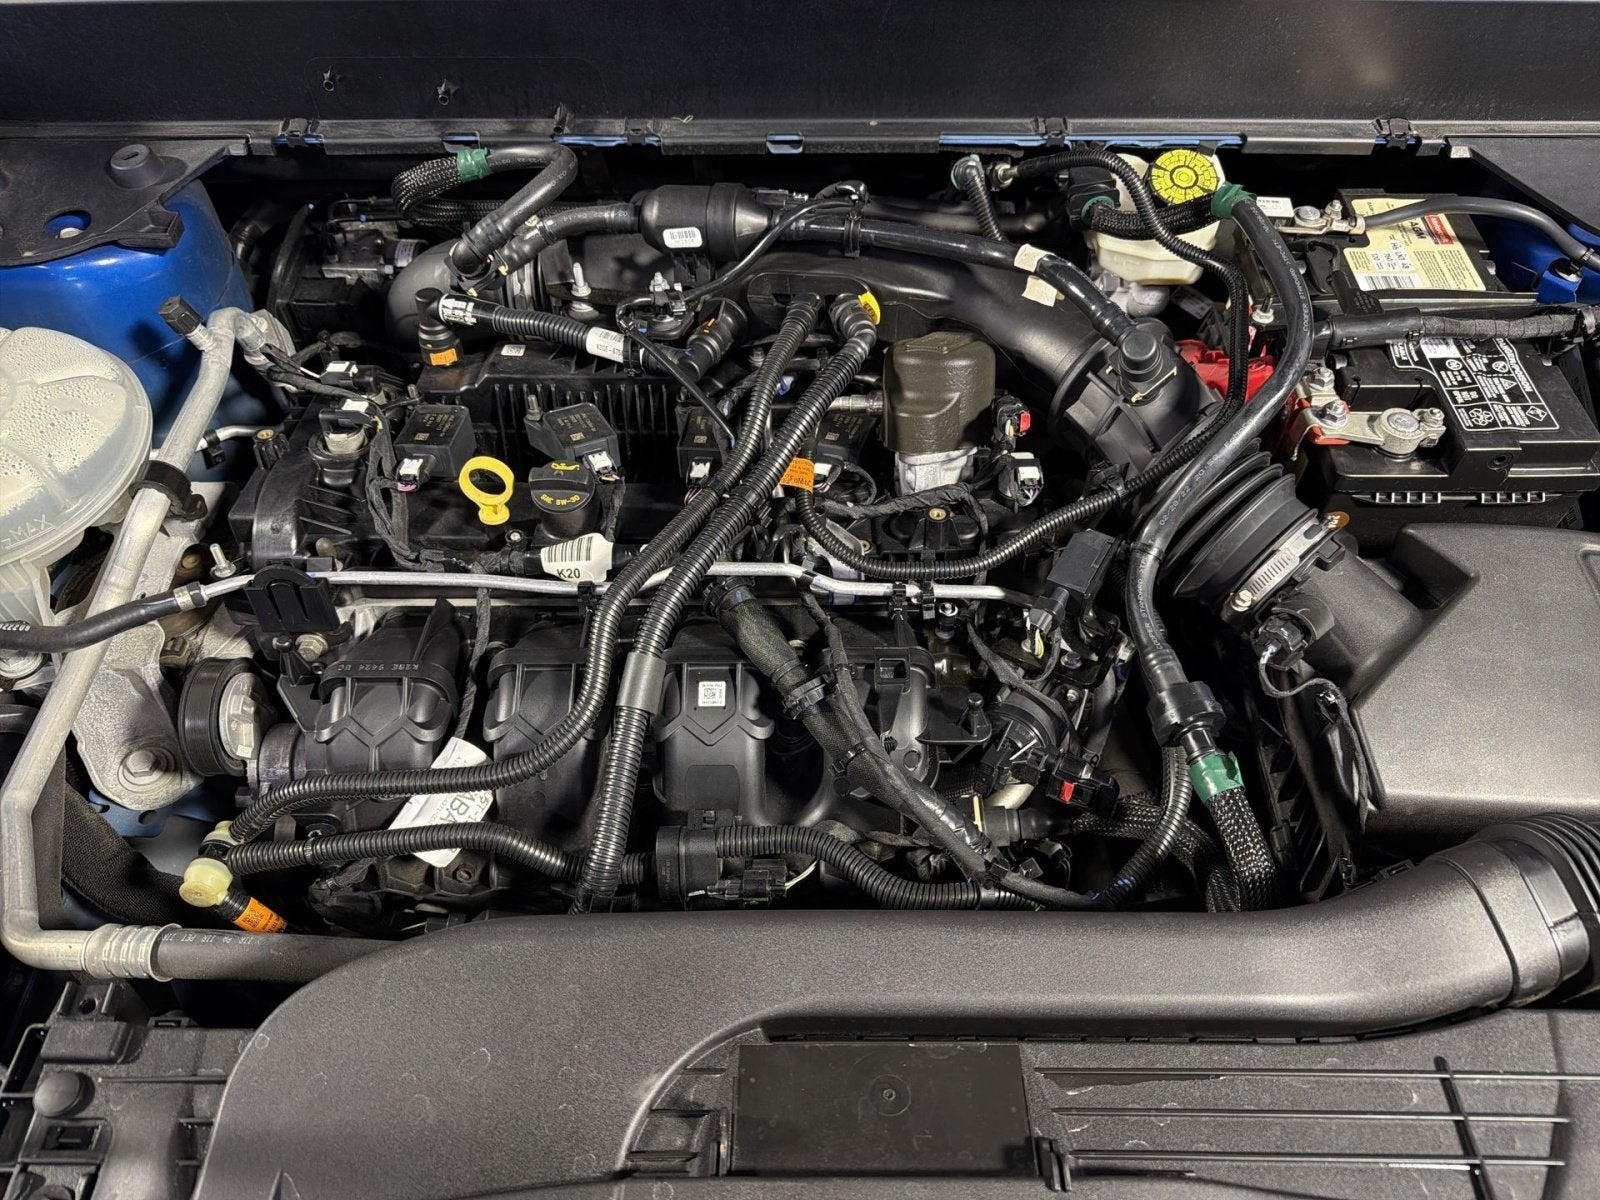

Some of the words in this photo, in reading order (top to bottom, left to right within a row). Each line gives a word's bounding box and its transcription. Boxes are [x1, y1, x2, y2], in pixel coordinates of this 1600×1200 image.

[555, 494, 580, 506] 5W-30
[9, 514, 55, 541] MAX
[556, 567, 581, 579] K20
[1137, 578, 1148, 618] STANDARD
[1144, 622, 1163, 650] COOPER
